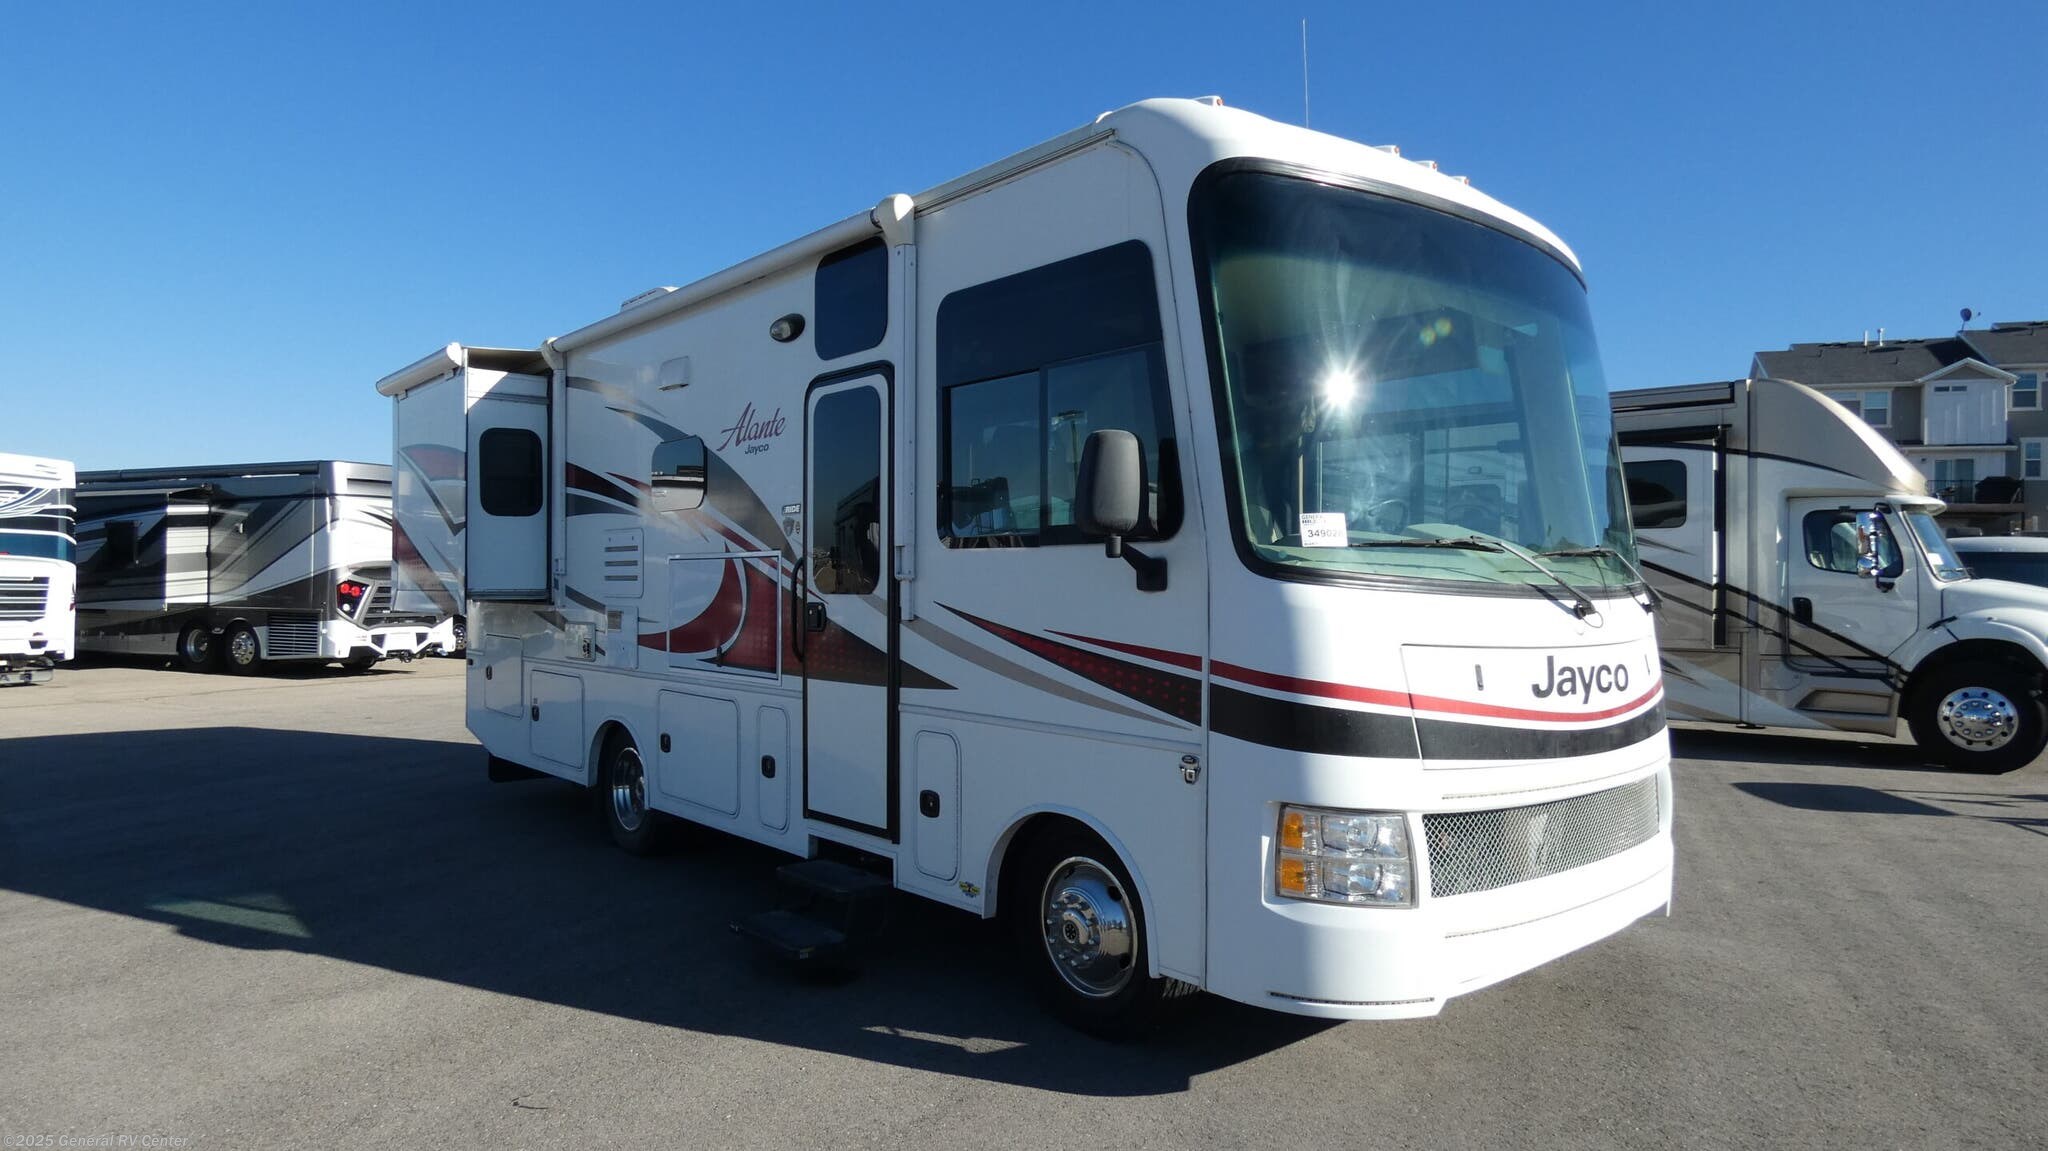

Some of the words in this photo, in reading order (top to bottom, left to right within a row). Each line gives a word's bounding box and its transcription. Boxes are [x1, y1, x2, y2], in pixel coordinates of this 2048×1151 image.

[716, 401, 787, 451] Alante
[744, 443, 770, 456] Jayco
[1531, 655, 1629, 705] Jayco
